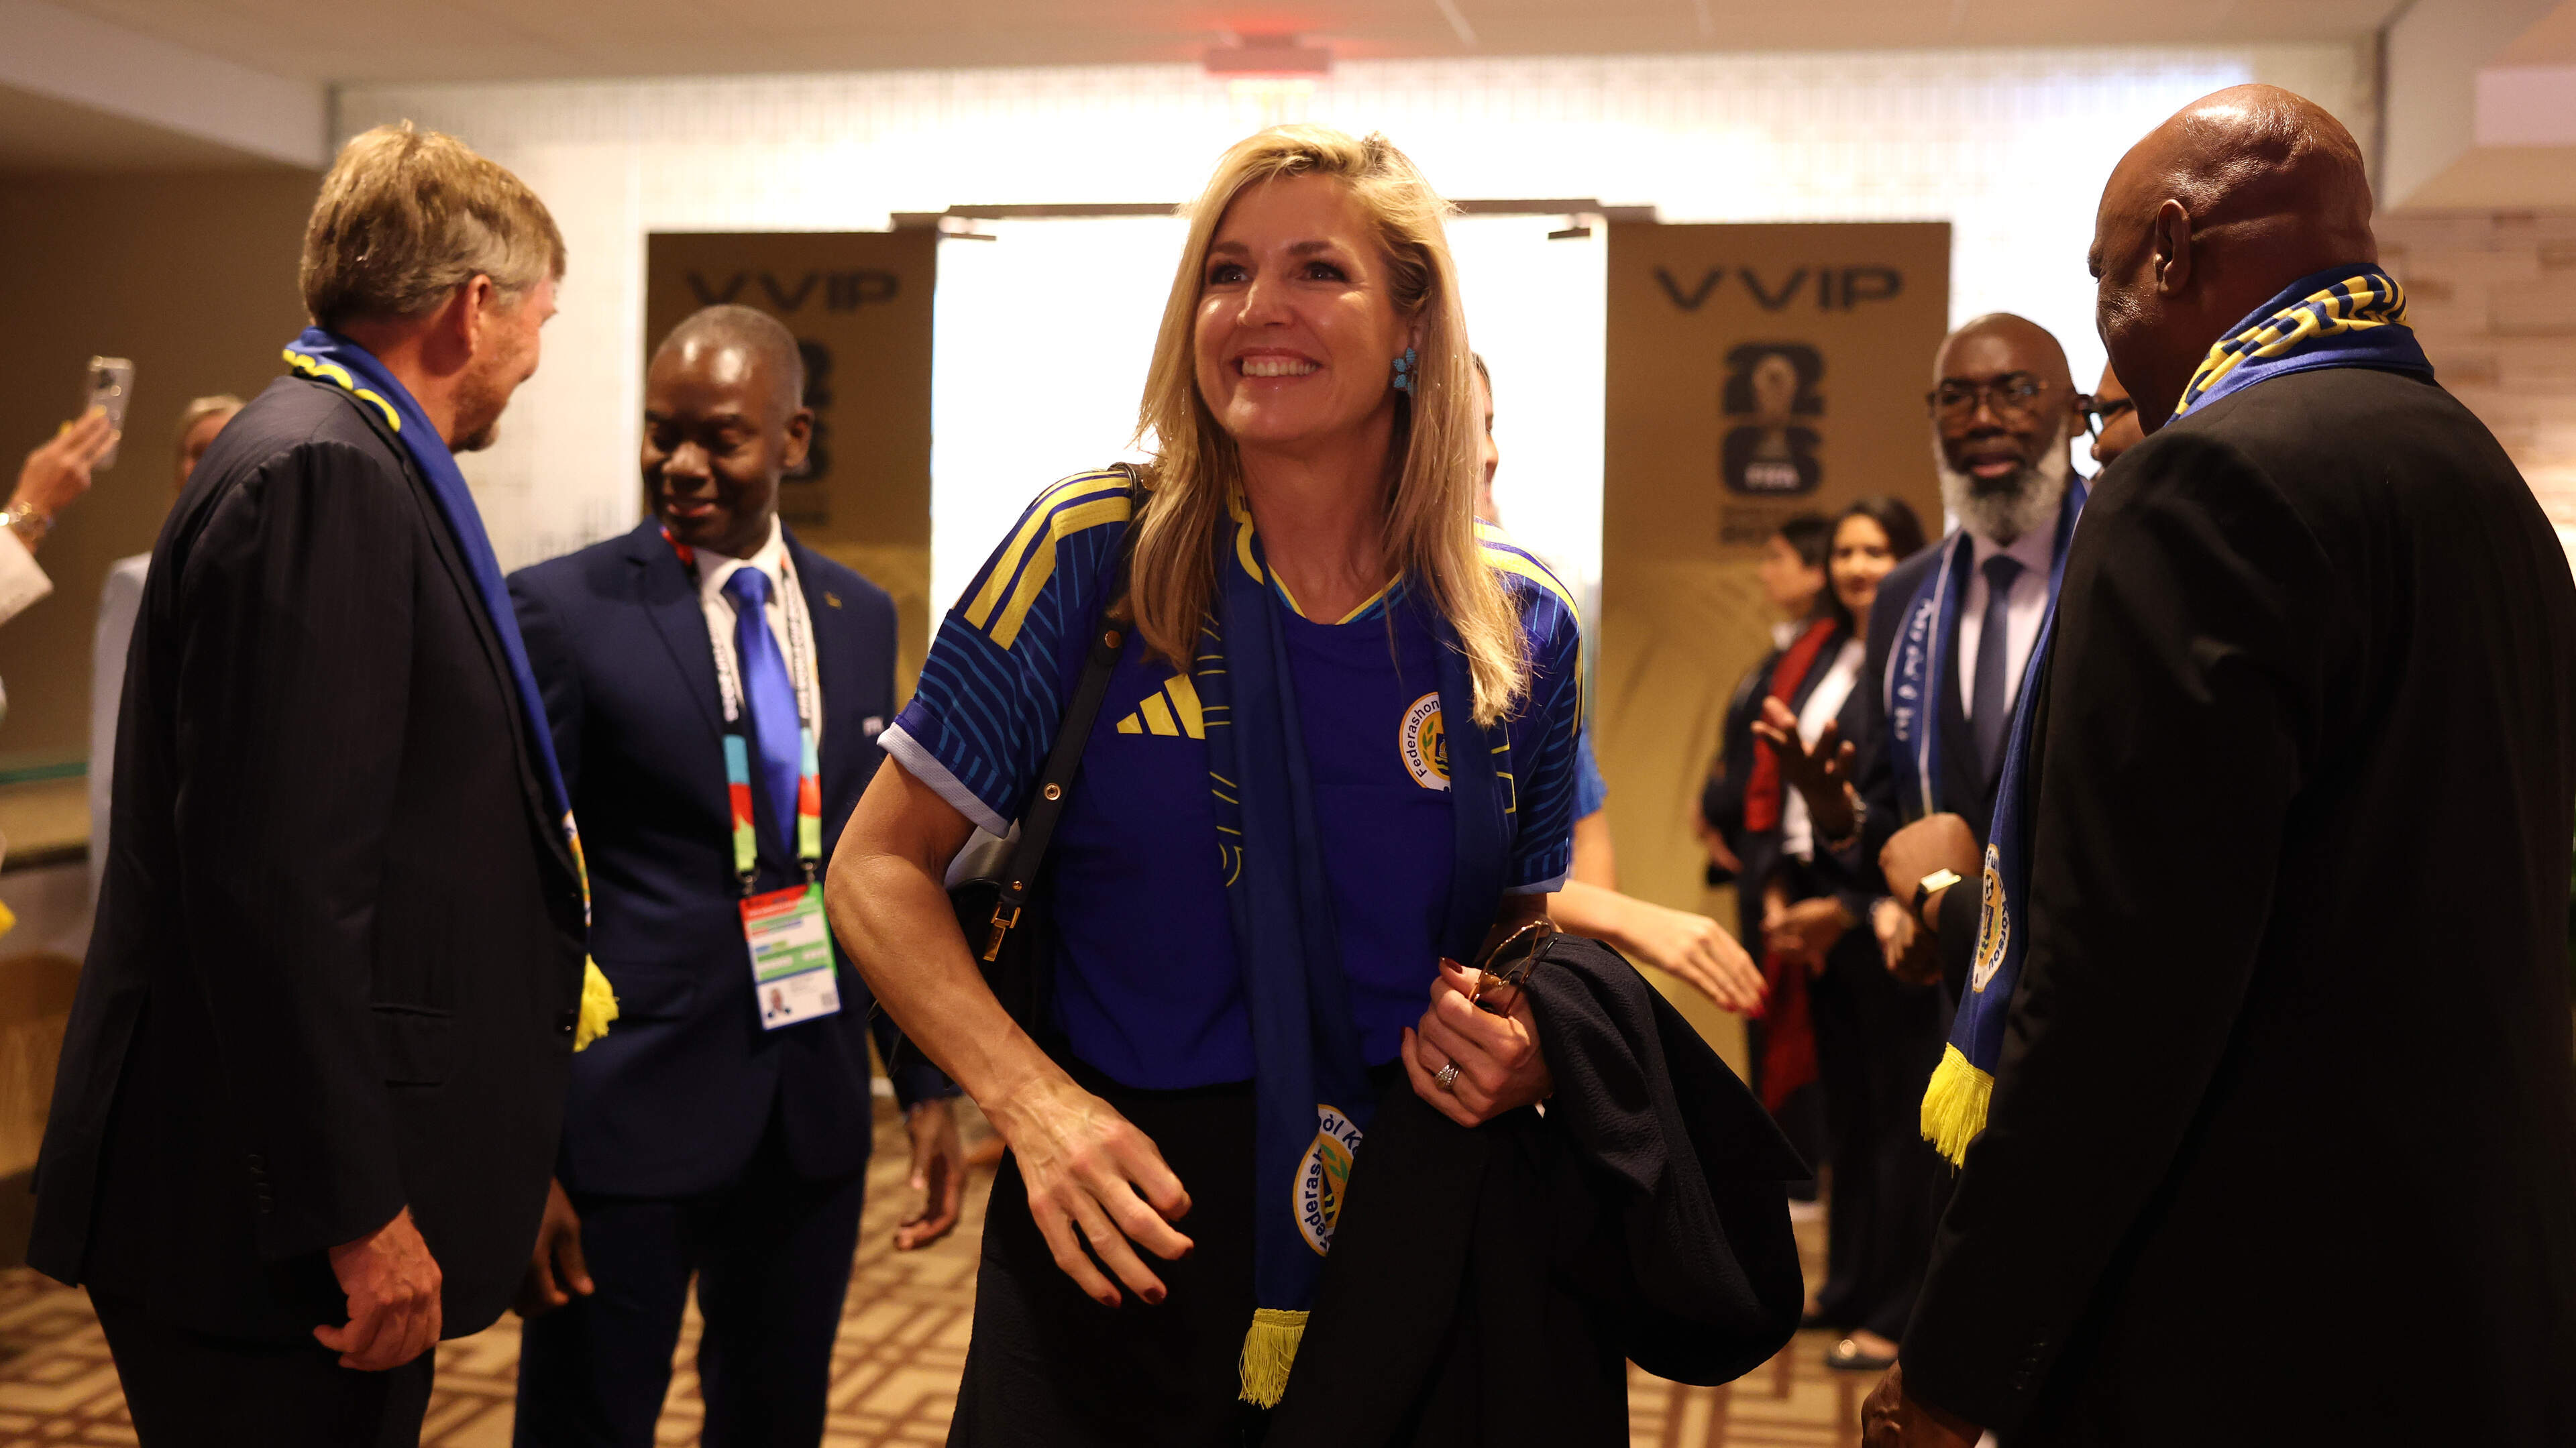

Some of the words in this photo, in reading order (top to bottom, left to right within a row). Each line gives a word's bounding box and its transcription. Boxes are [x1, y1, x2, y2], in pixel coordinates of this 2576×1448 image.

[686, 272, 900, 312] VVIP
[1654, 266, 1902, 311] VVIP
[1406, 700, 1441, 778] Federashon
